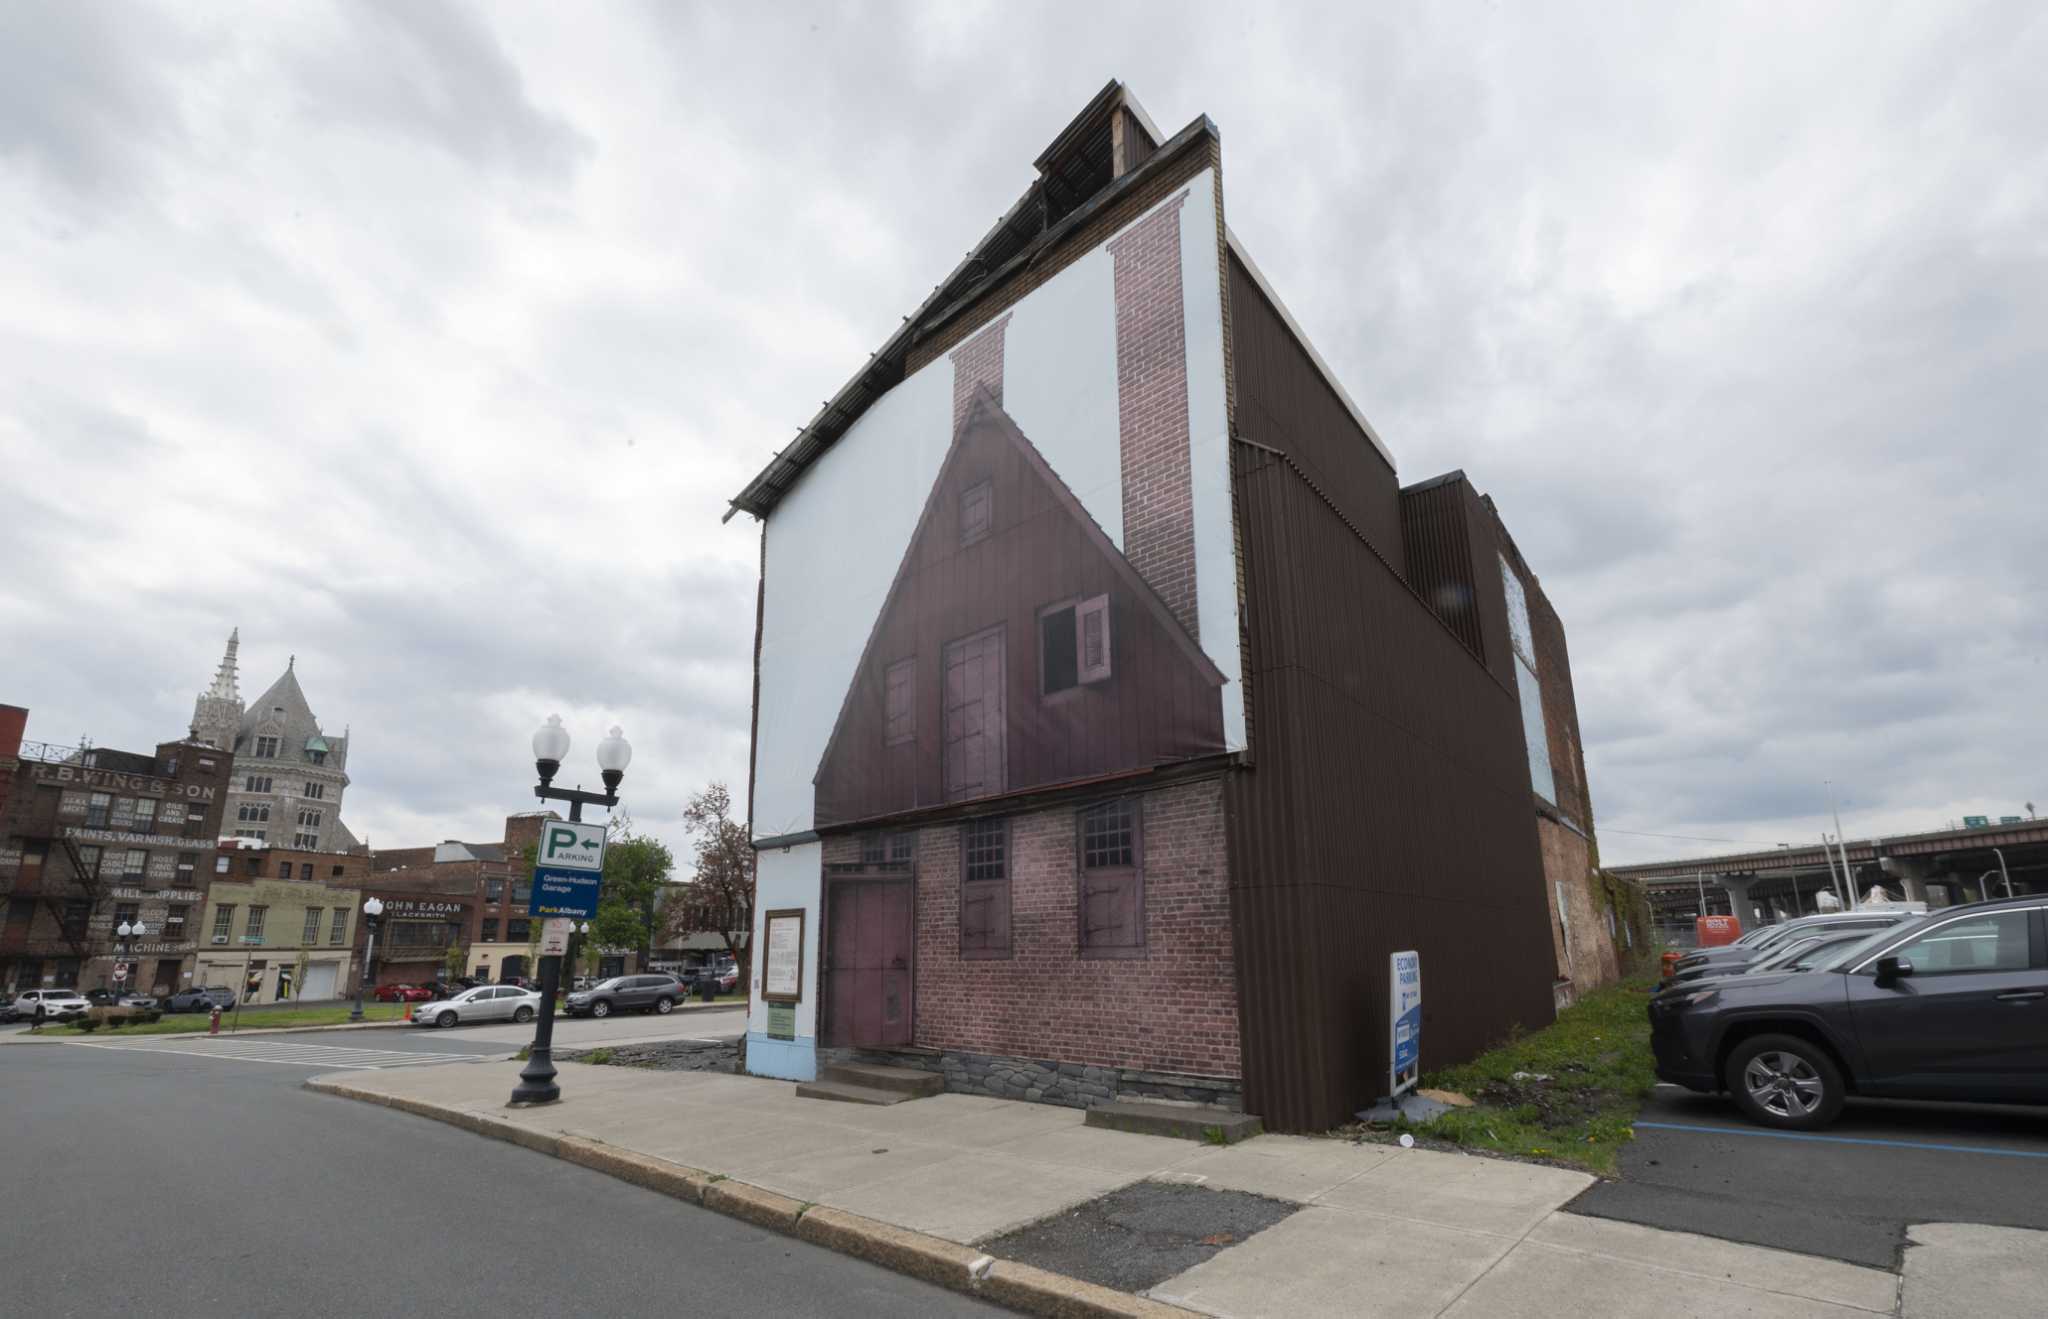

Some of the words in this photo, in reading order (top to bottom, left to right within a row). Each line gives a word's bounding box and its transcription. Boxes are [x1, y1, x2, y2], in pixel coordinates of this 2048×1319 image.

[175, 784, 216, 800] SON
[112, 887, 141, 898] MILL
[382, 901, 414, 911] OHN
[420, 902, 461, 913] EAGAN
